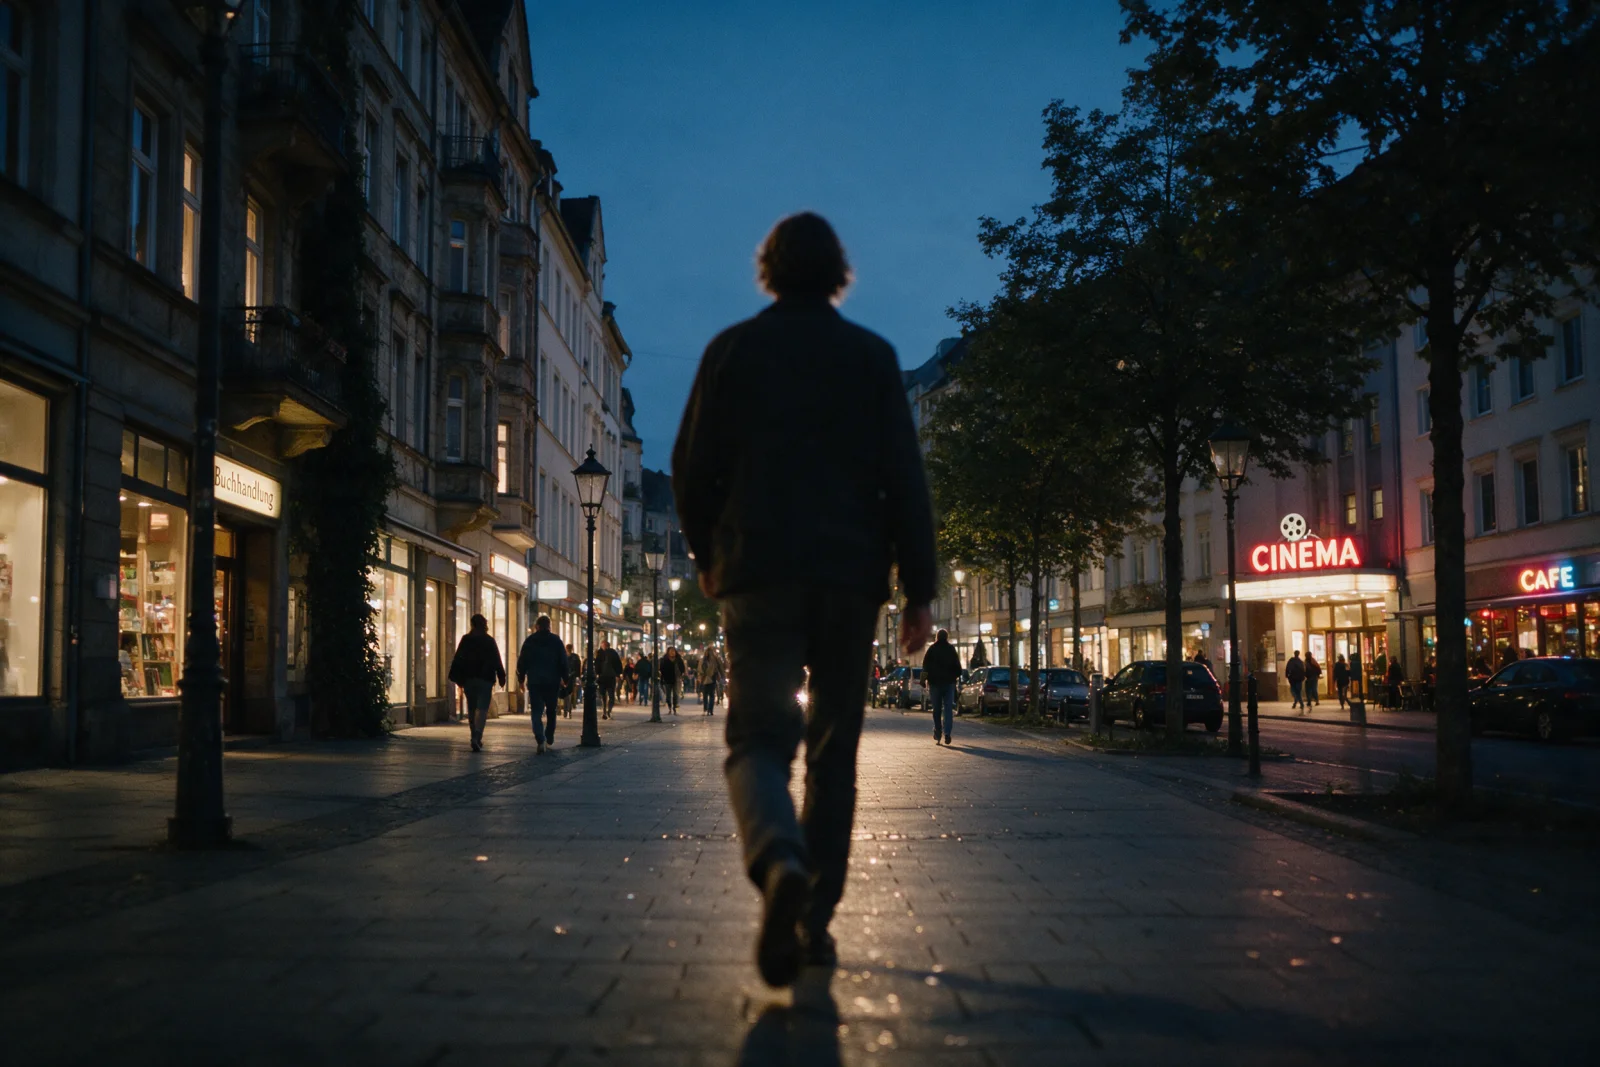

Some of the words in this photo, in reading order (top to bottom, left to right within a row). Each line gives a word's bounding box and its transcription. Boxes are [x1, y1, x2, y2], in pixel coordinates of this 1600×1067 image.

[215, 465, 274, 511] Buchhandlung
[1251, 537, 1360, 572] CINEMA
[1520, 566, 1575, 591] CAFE
